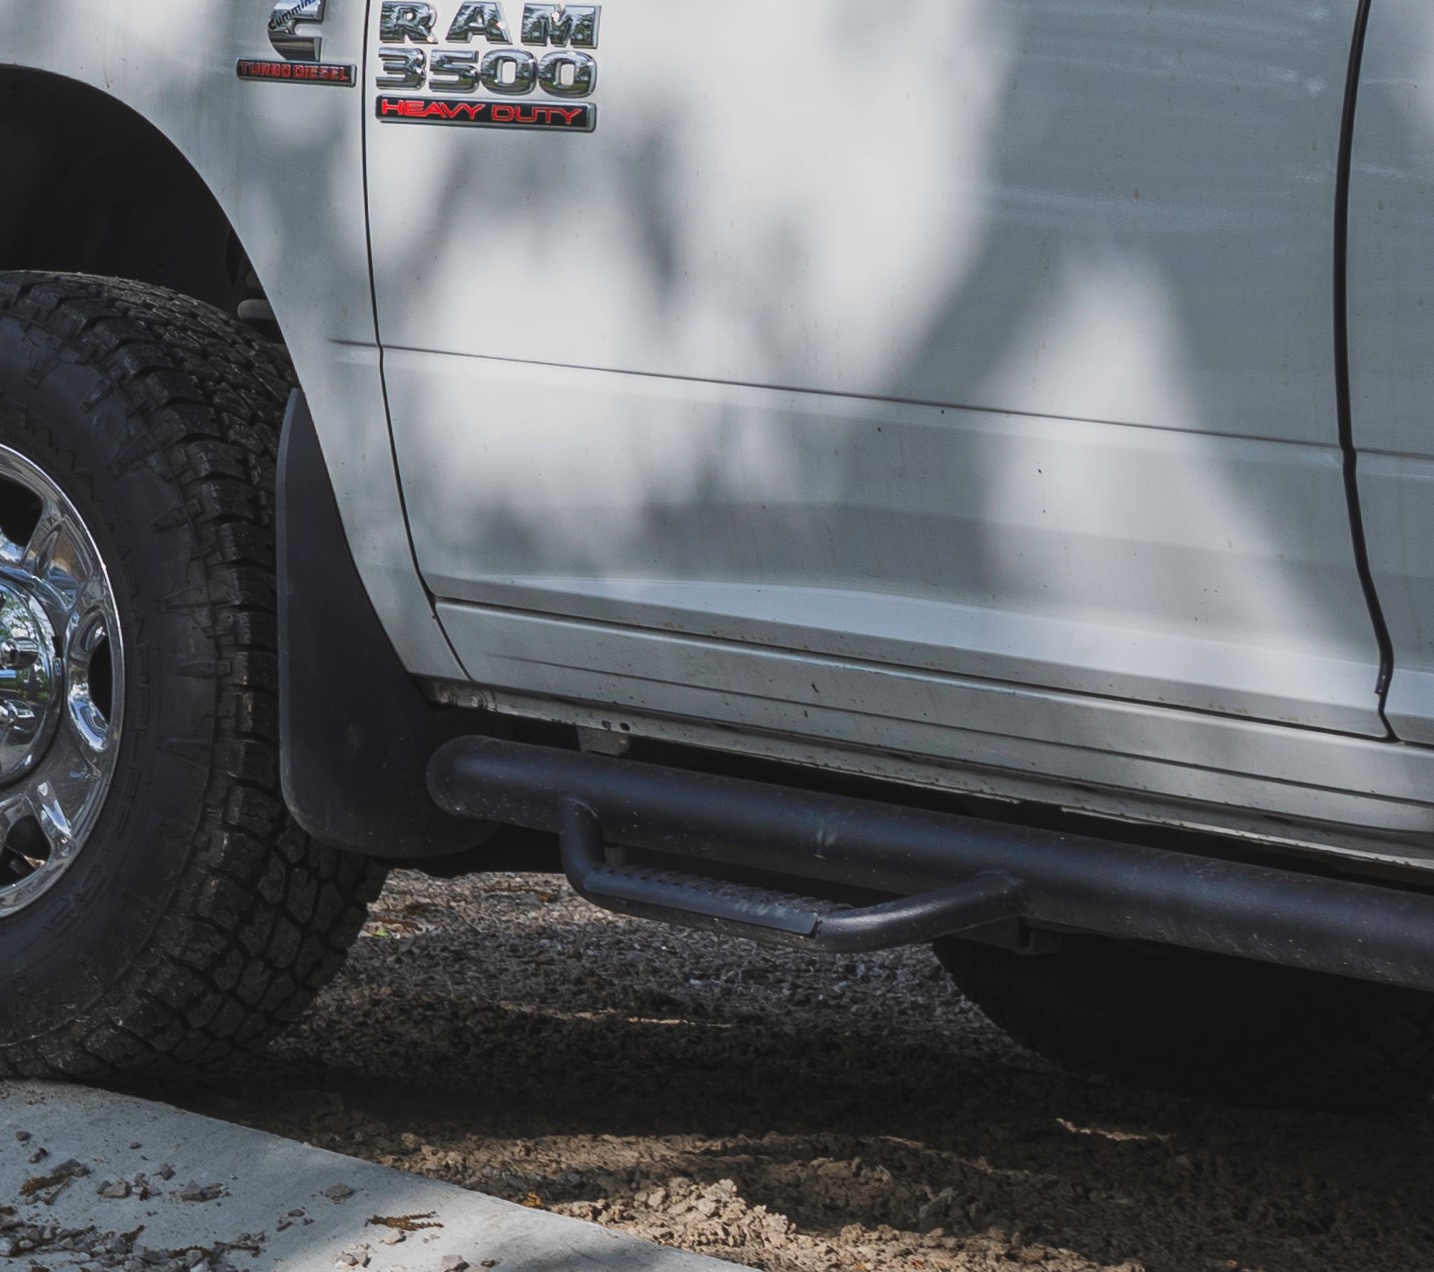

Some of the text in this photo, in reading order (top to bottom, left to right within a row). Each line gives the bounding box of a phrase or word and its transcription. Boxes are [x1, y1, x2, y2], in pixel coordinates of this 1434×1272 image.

[379, 0, 602, 49] RAM
[240, 61, 349, 81] TURBO DIESEL
[375, 47, 597, 99] 3500
[381, 99, 583, 125] HEAVY DUTY
